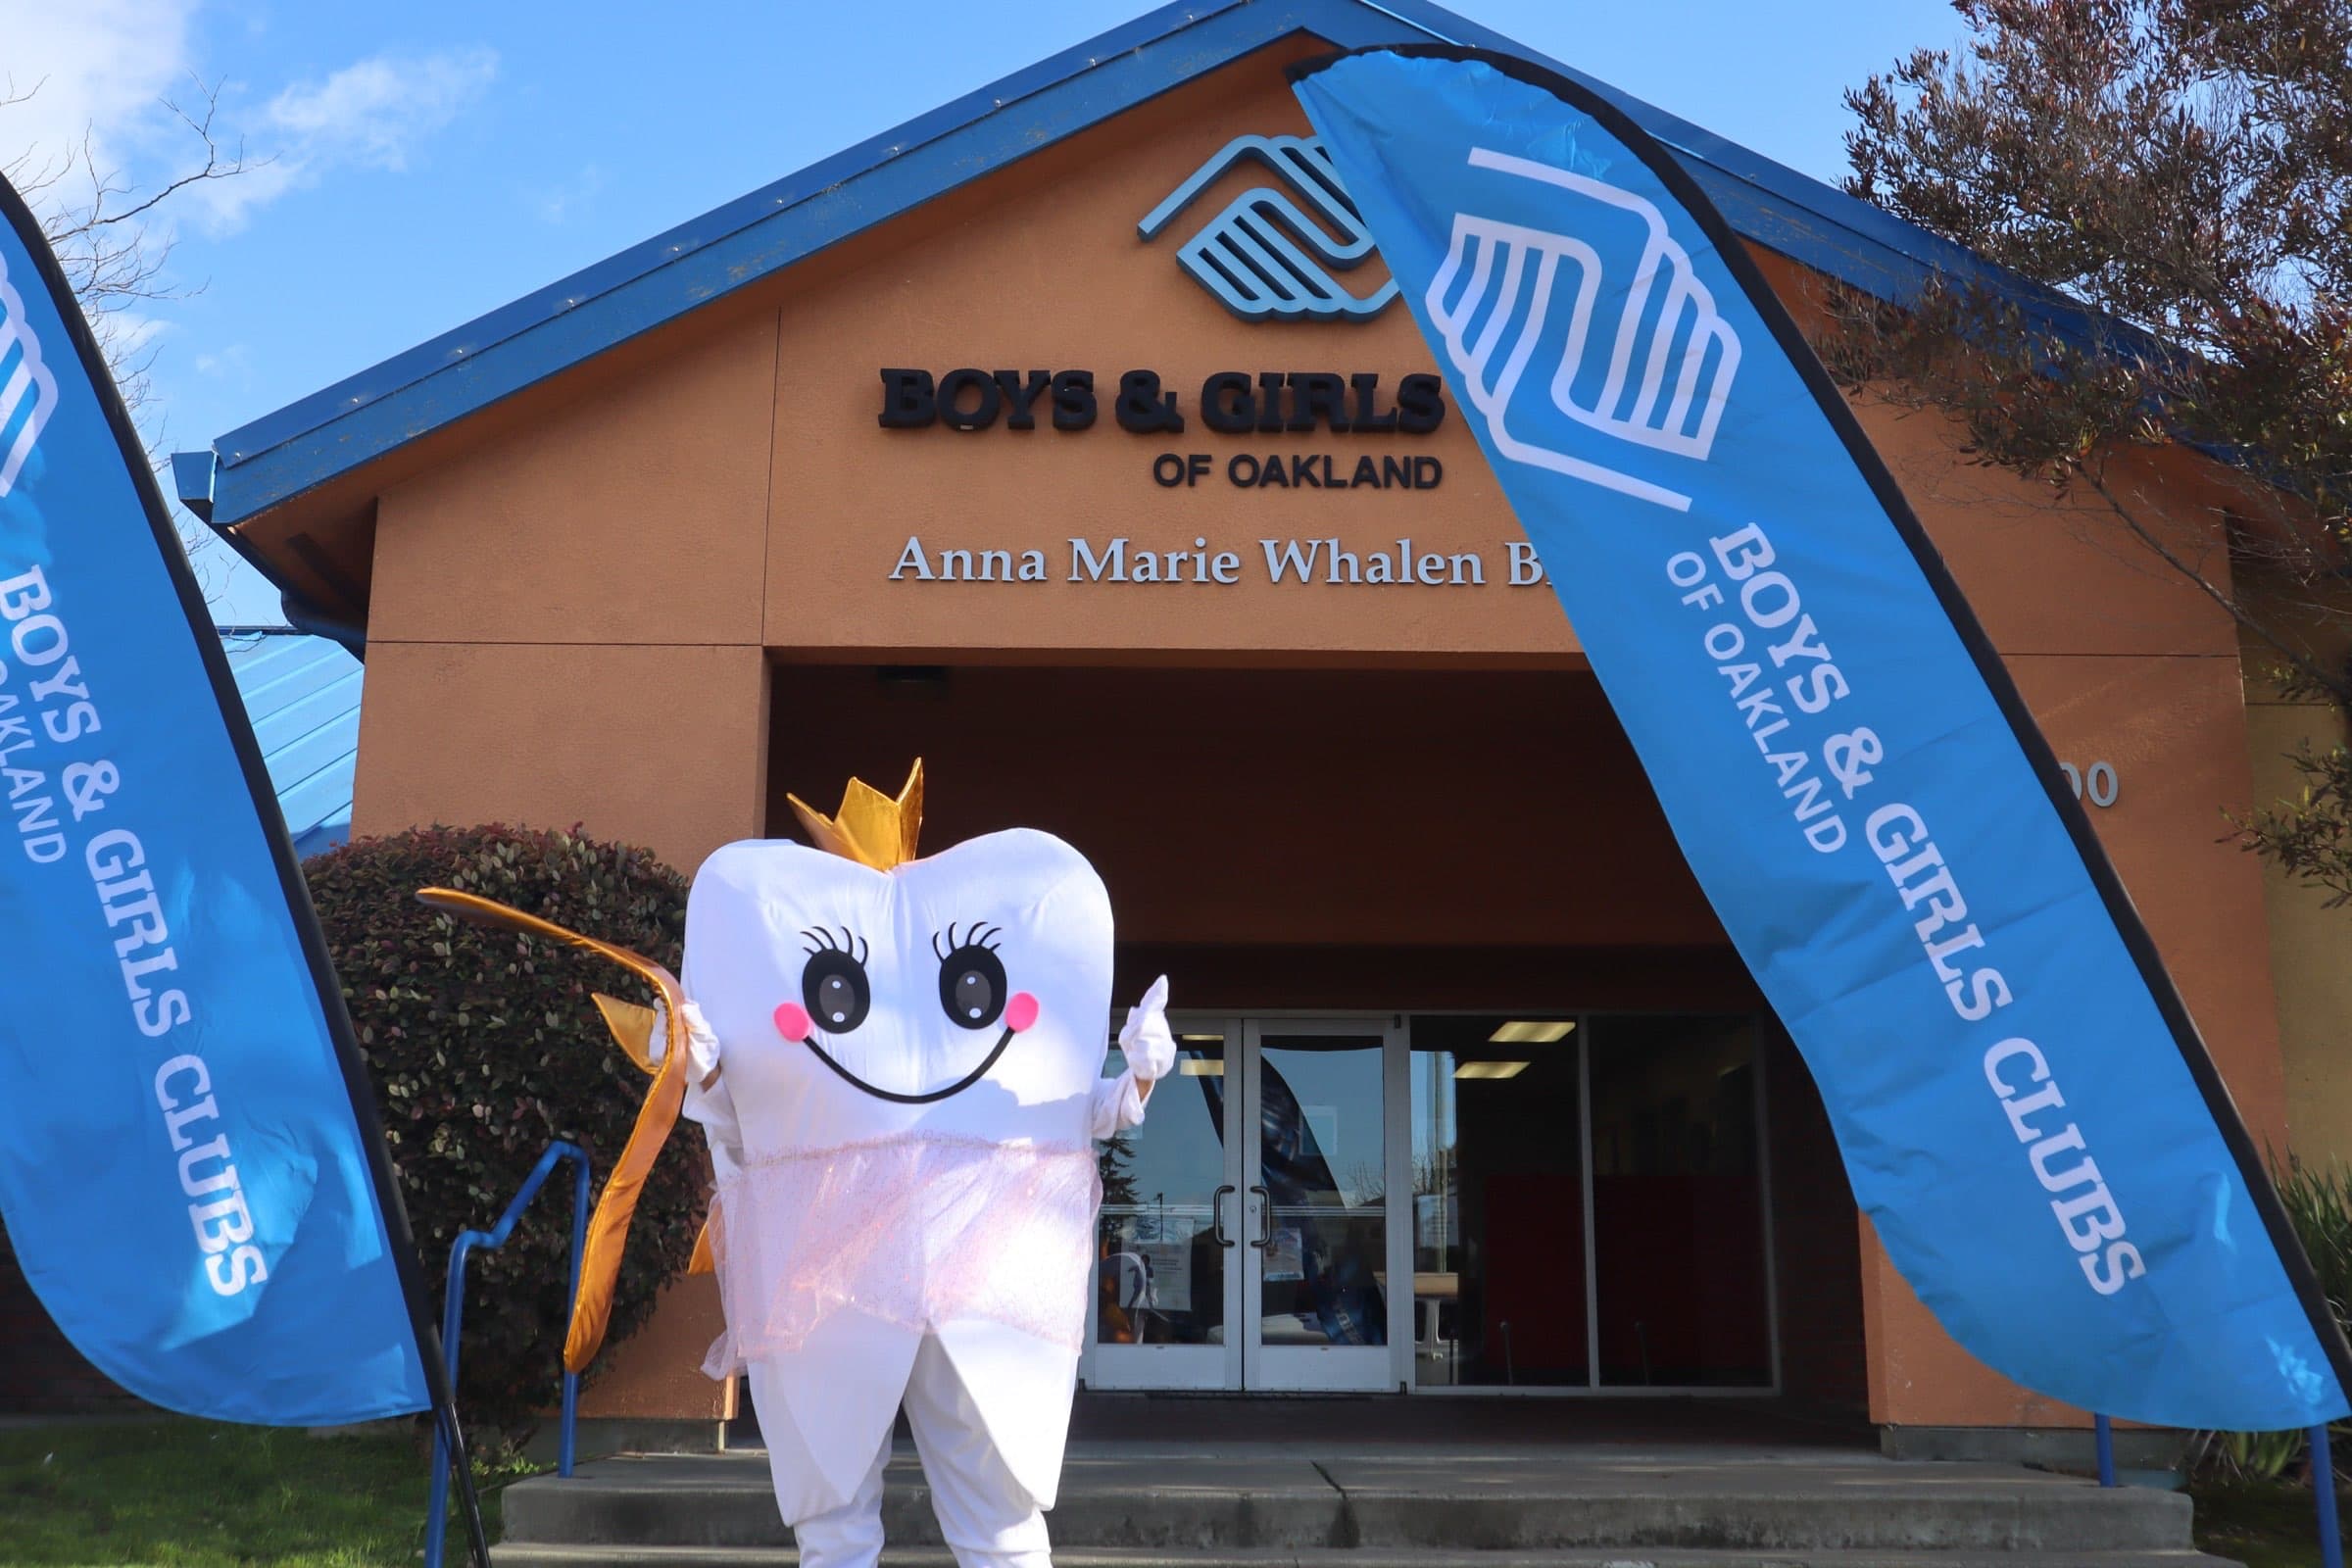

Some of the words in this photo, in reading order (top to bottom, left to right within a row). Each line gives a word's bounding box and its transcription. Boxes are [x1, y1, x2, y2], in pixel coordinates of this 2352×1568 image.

[878, 368, 1097, 431] BOYS
[1115, 369, 1185, 433] &
[1200, 370, 1446, 435] GIRLS
[1153, 453, 1211, 488] OF
[1228, 454, 1443, 489] OAKLAND
[0, 564, 101, 743] BOYS
[888, 536, 1048, 581] Anna
[1067, 537, 1240, 584] Marie
[1259, 538, 1487, 585] Whalen
[1504, 541, 1553, 587] B
[0, 660, 67, 863] KLAND
[62, 760, 120, 821] &
[1667, 552, 1724, 610] OF
[1704, 623, 1847, 854] OAKLAND
[85, 829, 191, 1037] GIRLS
[1709, 522, 1850, 713] BOYS
[1823, 726, 1884, 800] &
[1865, 803, 2013, 1021] GIRLS
[1984, 1038, 2145, 1296] CLUBS
[155, 1054, 269, 1297] CLUBS
